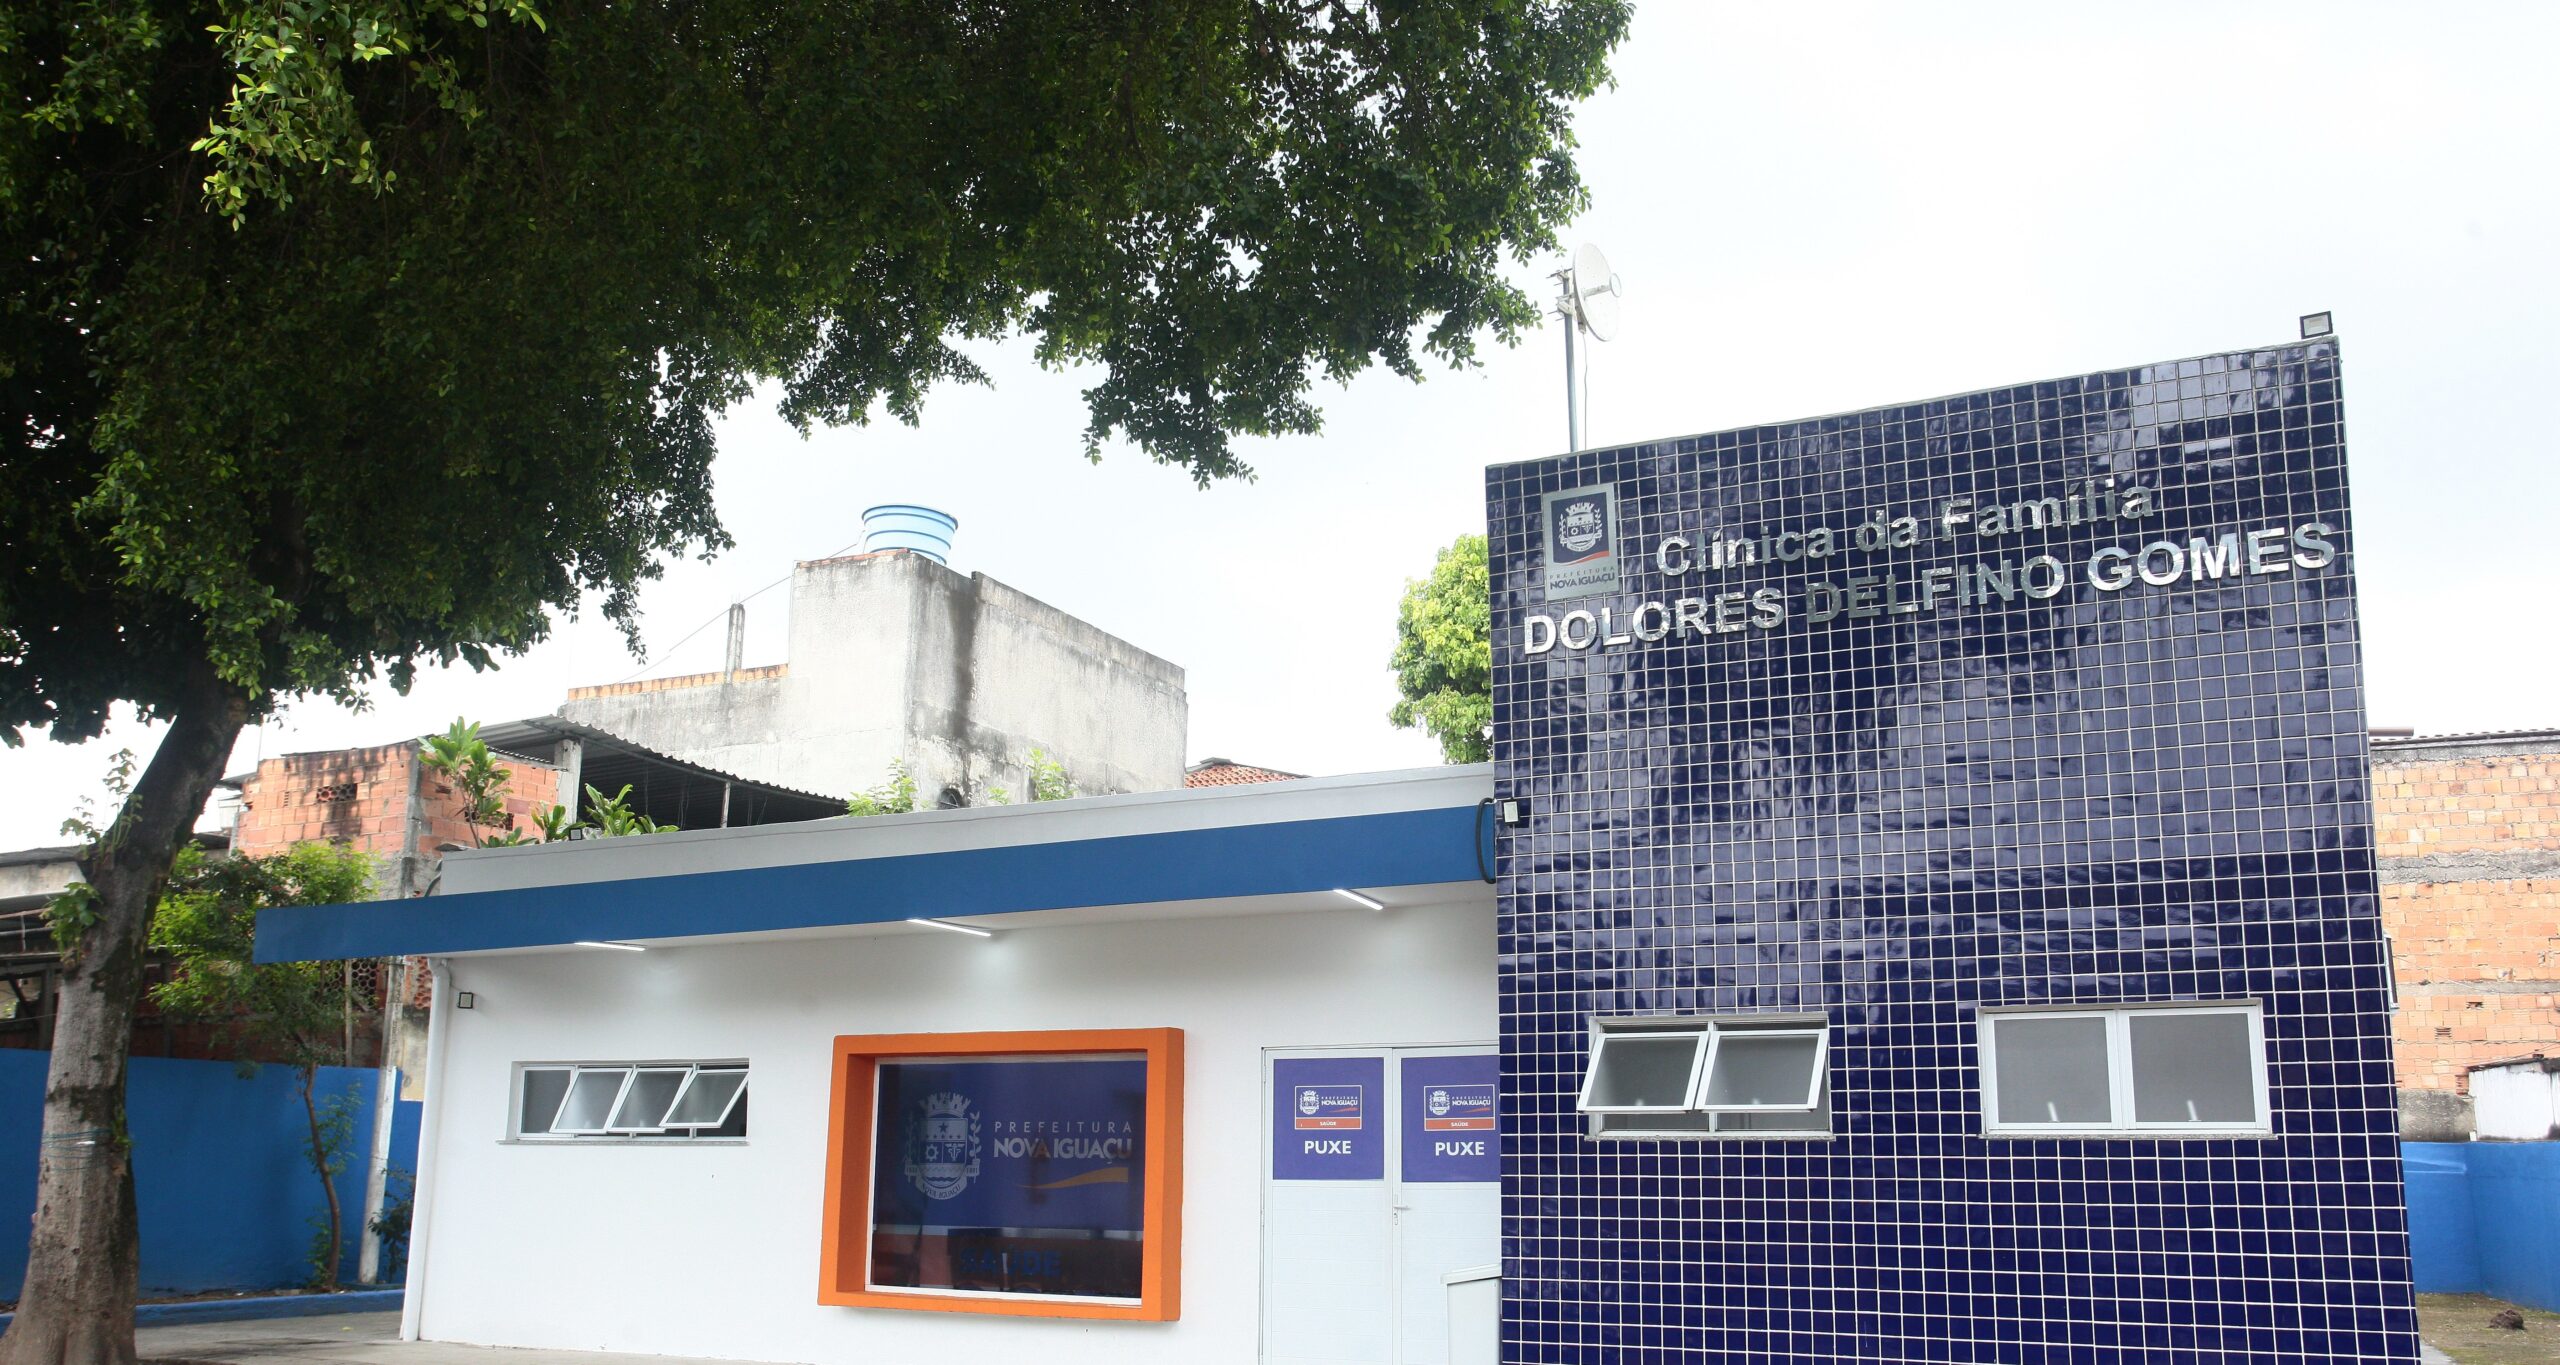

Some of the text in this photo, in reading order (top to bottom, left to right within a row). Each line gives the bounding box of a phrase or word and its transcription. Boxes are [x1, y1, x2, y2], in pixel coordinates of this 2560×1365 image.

[1657, 478, 2154, 577] Clínica da Família
[1550, 567, 1615, 579] PREFEITURA
[1550, 572, 1615, 590] NOVA IGUAÇU
[1523, 522, 2335, 655] DOLORES DELFINO GOMES
[994, 1121, 1132, 1133] PREFEITURA
[994, 1138, 1132, 1164] NOVA IGUAÇU
[1304, 1140, 1351, 1154] PUXE
[1435, 1141, 1485, 1156] PUXE
[960, 1244, 1061, 1277] SAÚDE
